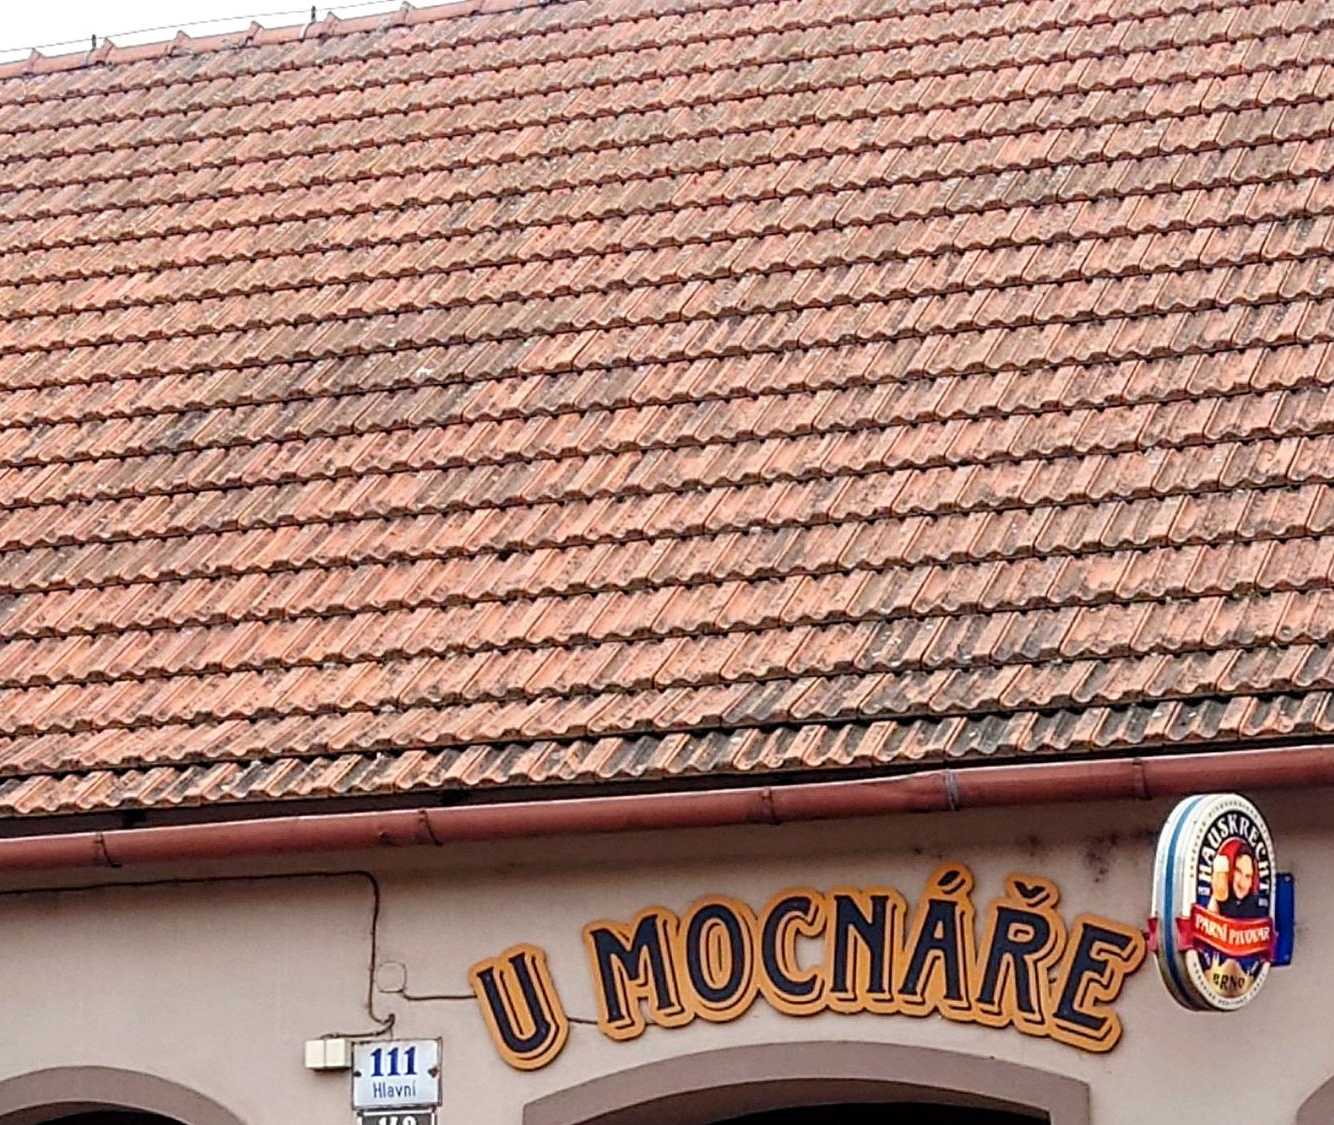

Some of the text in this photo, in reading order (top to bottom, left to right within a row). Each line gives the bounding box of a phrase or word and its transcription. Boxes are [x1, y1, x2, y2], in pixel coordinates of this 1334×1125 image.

[1198, 813, 1270, 896] HAUSKRECHT
[1195, 914, 1270, 946] PARNÍ PIVOVAR
[473, 866, 1139, 1062] U MOCNÁŘE
[1213, 973, 1246, 991] BRNO
[370, 1046, 418, 1077] 111
[372, 1080, 416, 1099] Hlavní
